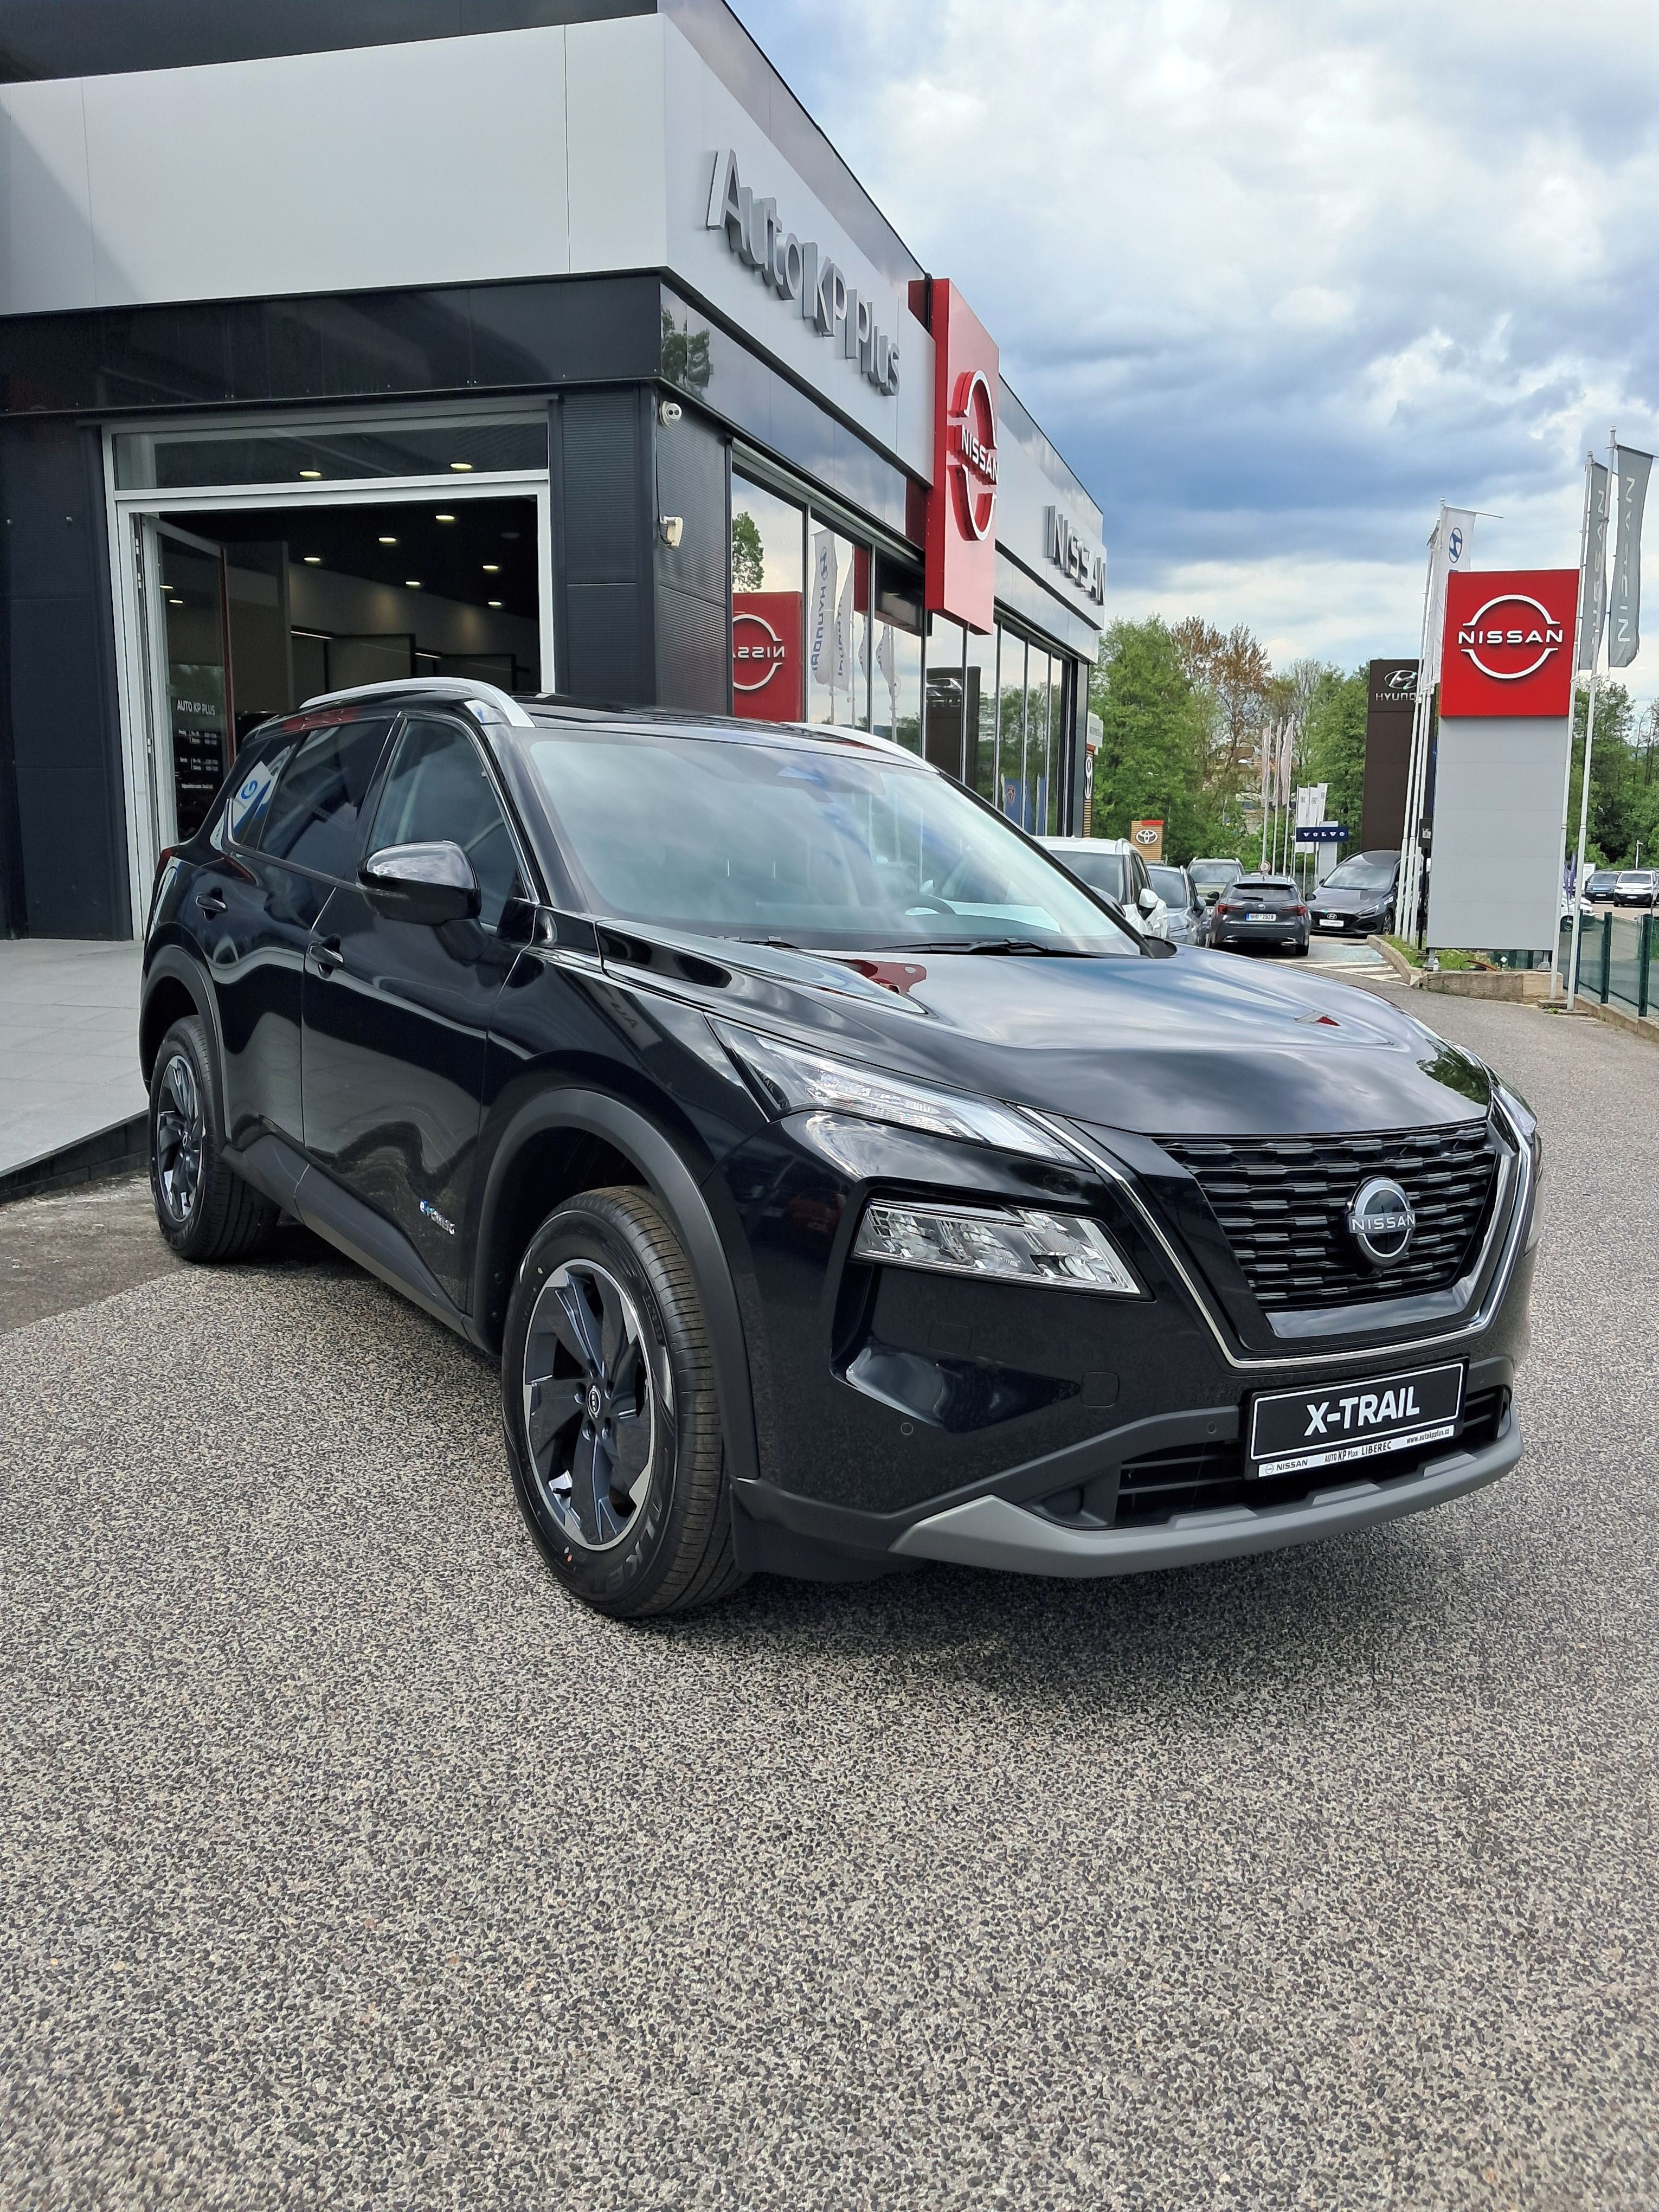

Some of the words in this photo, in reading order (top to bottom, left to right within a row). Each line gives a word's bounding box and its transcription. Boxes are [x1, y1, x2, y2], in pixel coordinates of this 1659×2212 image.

[961, 424, 999, 484] NISSAN
[1047, 505, 1105, 606] NISSAN
[1458, 629, 1563, 644] NISSAN
[177, 699, 192, 712] AUTO
[192, 702, 201, 713] KP
[201, 703, 215, 716] PLUS
[1375, 692, 1416, 701] HYUND
[1352, 1214, 1415, 1231] NISSAN
[1304, 1386, 1420, 1436] X-TRAIL
[1276, 1459, 1308, 1471] NISSAN
[1324, 1455, 1337, 1463] AUTO
[1338, 1450, 1347, 1461] KP
[1348, 1450, 1358, 1458] Plus
[1361, 1441, 1392, 1456] LIBEREC
